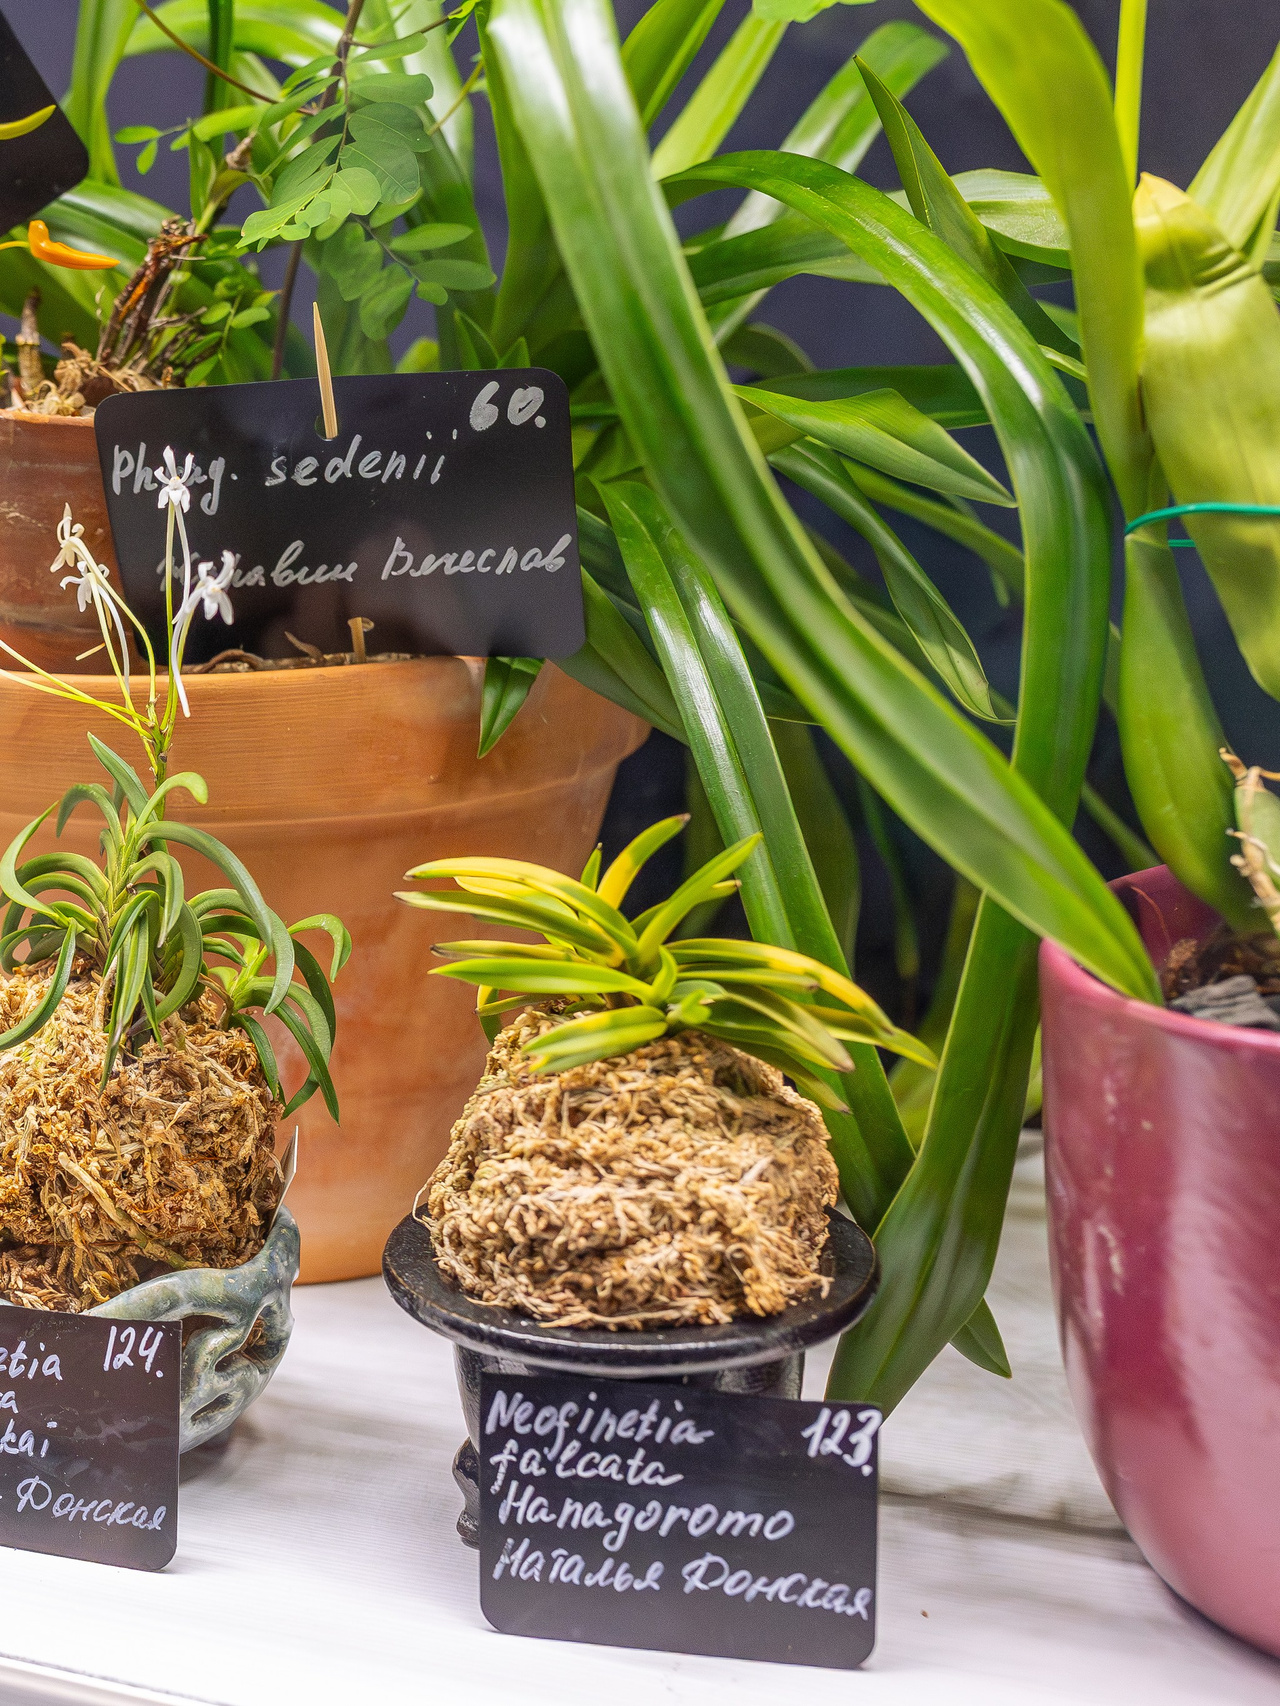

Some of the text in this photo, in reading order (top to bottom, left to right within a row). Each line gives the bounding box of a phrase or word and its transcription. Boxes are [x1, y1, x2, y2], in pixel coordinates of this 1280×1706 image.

[469, 380, 546, 432] 60.
[264, 428, 459, 487] sedenii
[104, 1326, 164, 1378] 124.
[485, 1390, 714, 1460] Neofinetia
[801, 1408, 883, 1476] 123.
[489, 1438, 684, 1494] falcata
[16, 1475, 167, 1531] Донская
[498, 1480, 795, 1552] Hanagoromo
[492, 1538, 873, 1620] Наталья Донская
